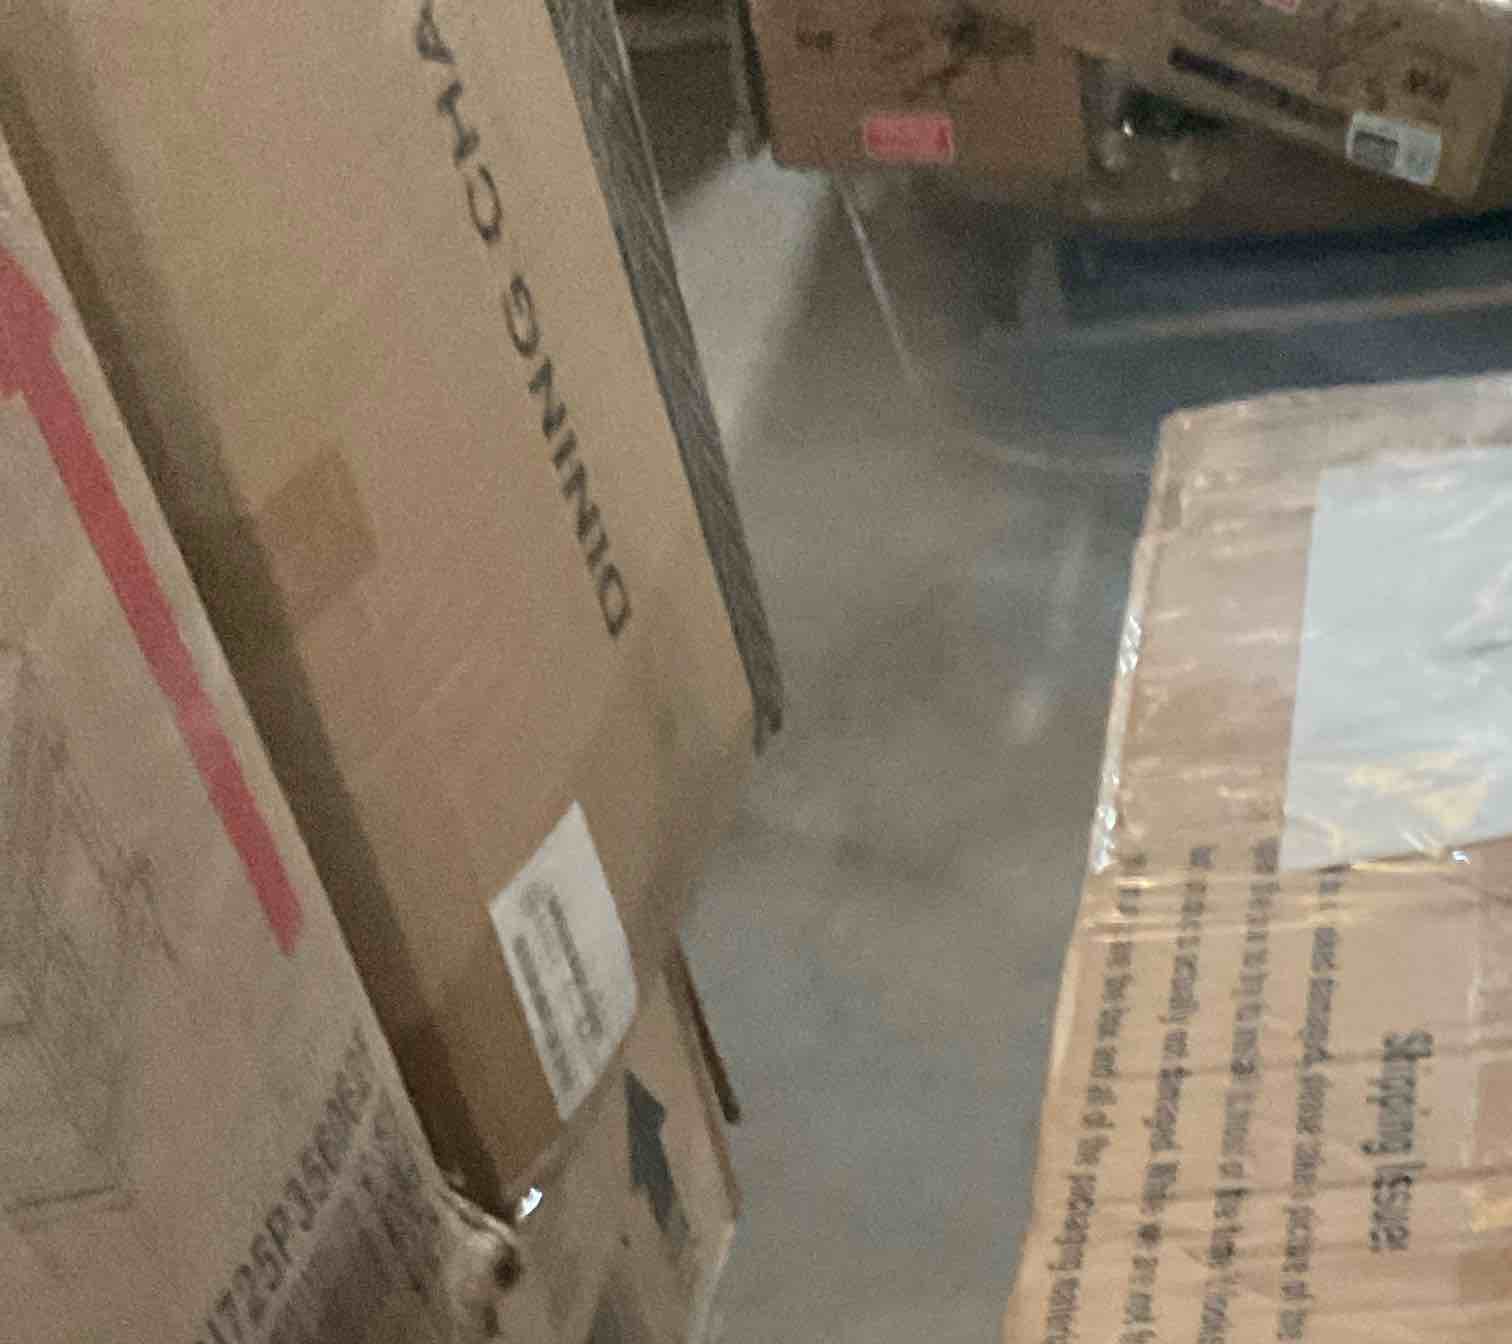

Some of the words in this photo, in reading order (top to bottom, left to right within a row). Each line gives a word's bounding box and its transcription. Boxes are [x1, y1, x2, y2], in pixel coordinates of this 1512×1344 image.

[504, 273, 632, 639] DINING
[1362, 1031, 1434, 1157] Shipping
[1047, 1173, 1100, 1271] packaging
